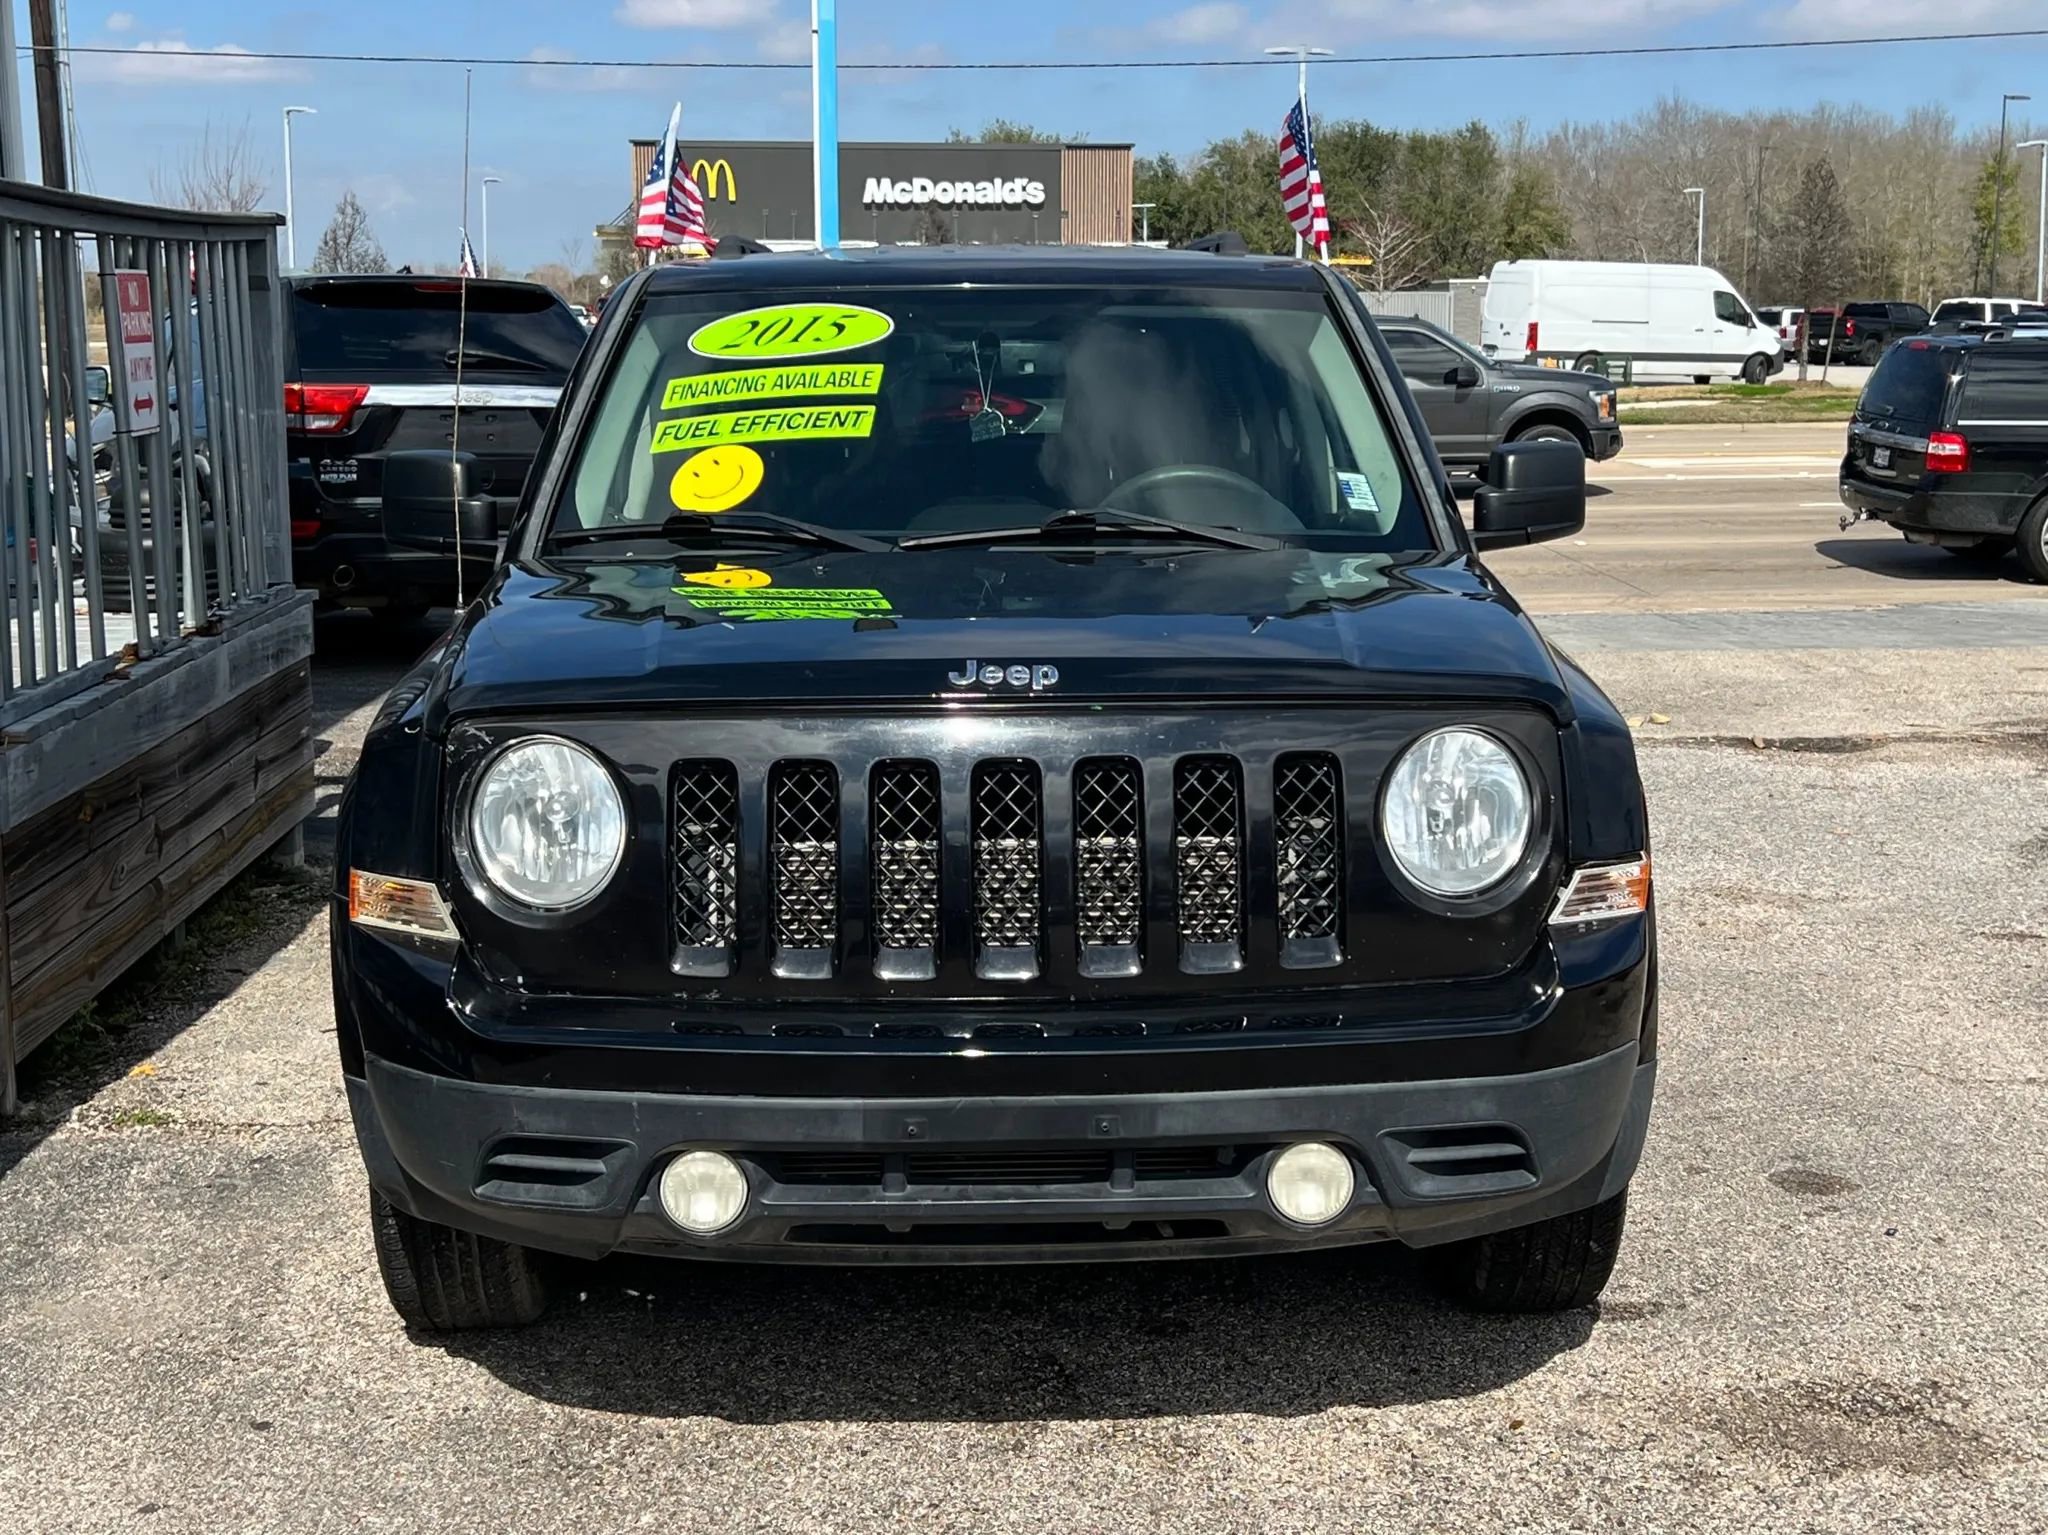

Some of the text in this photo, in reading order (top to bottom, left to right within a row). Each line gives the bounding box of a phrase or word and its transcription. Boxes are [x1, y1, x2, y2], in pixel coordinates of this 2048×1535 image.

[862, 177, 1046, 205] McDonald's
[128, 281, 140, 307] NO
[122, 312, 151, 337] PARKING
[719, 314, 859, 350] 2015
[130, 357, 154, 382] ANYTIME
[451, 391, 494, 406] Jeep
[669, 370, 875, 402] FINANCING AVAILABLE
[657, 410, 871, 444] FUEL EFFICIENT
[948, 659, 1059, 690] Jeep
